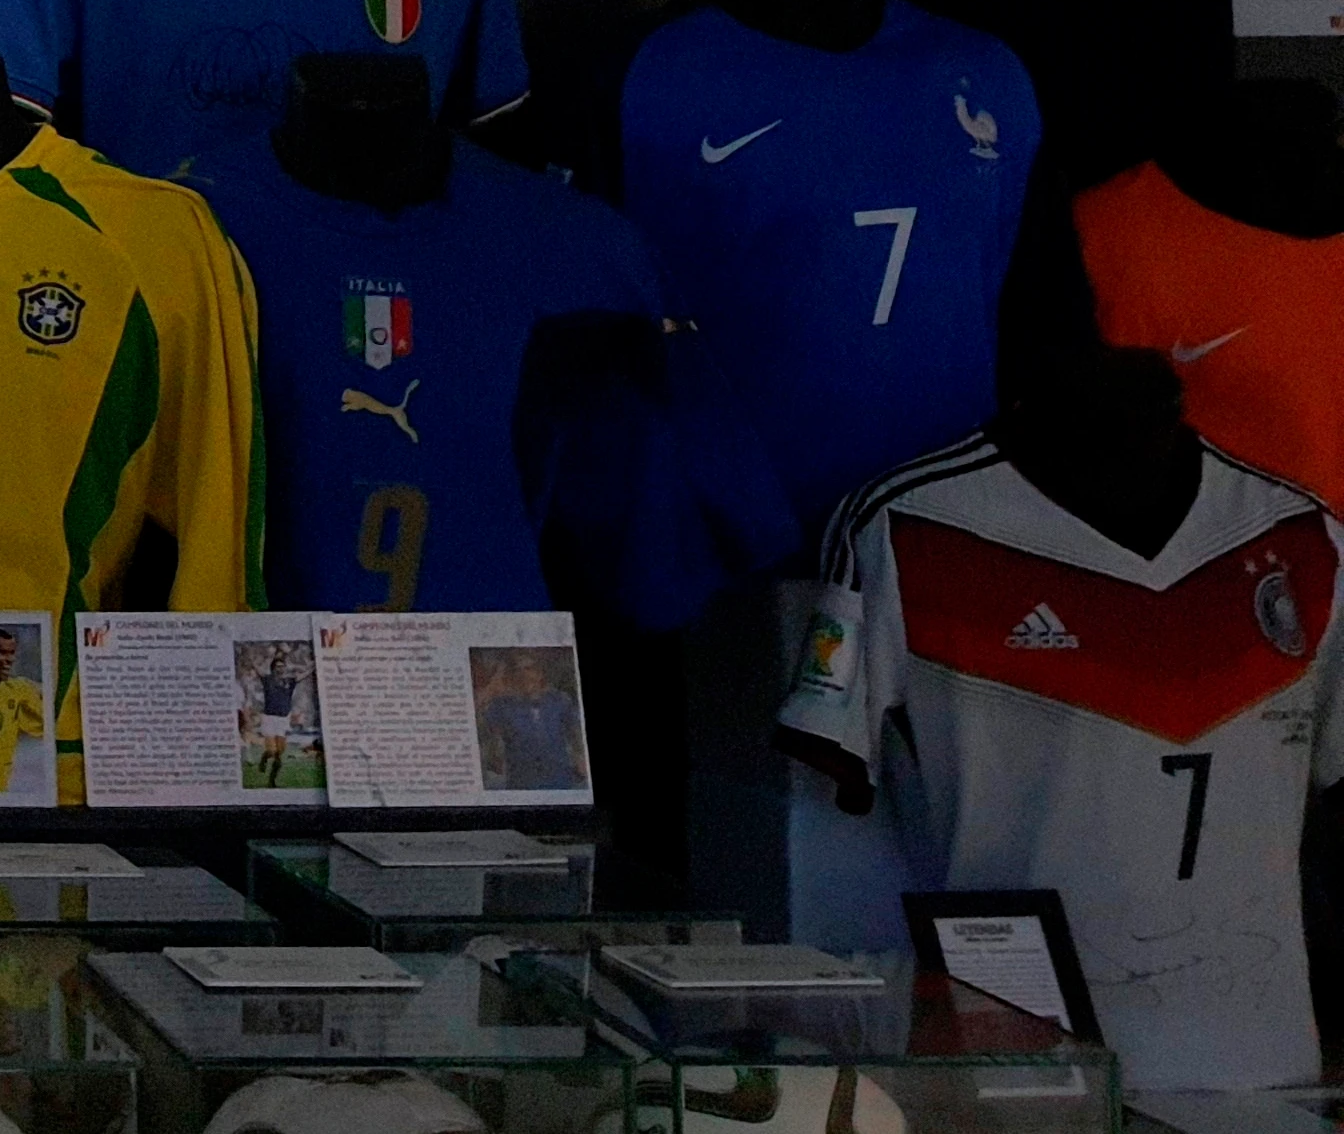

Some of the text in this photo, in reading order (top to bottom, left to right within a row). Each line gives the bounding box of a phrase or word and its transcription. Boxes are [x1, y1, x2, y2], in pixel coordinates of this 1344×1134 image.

[349, 279, 406, 294] ITALIA
[854, 207, 918, 326] 7
[357, 482, 430, 613] 9
[1003, 633, 1080, 649] adidas
[1161, 753, 1212, 880] 7
